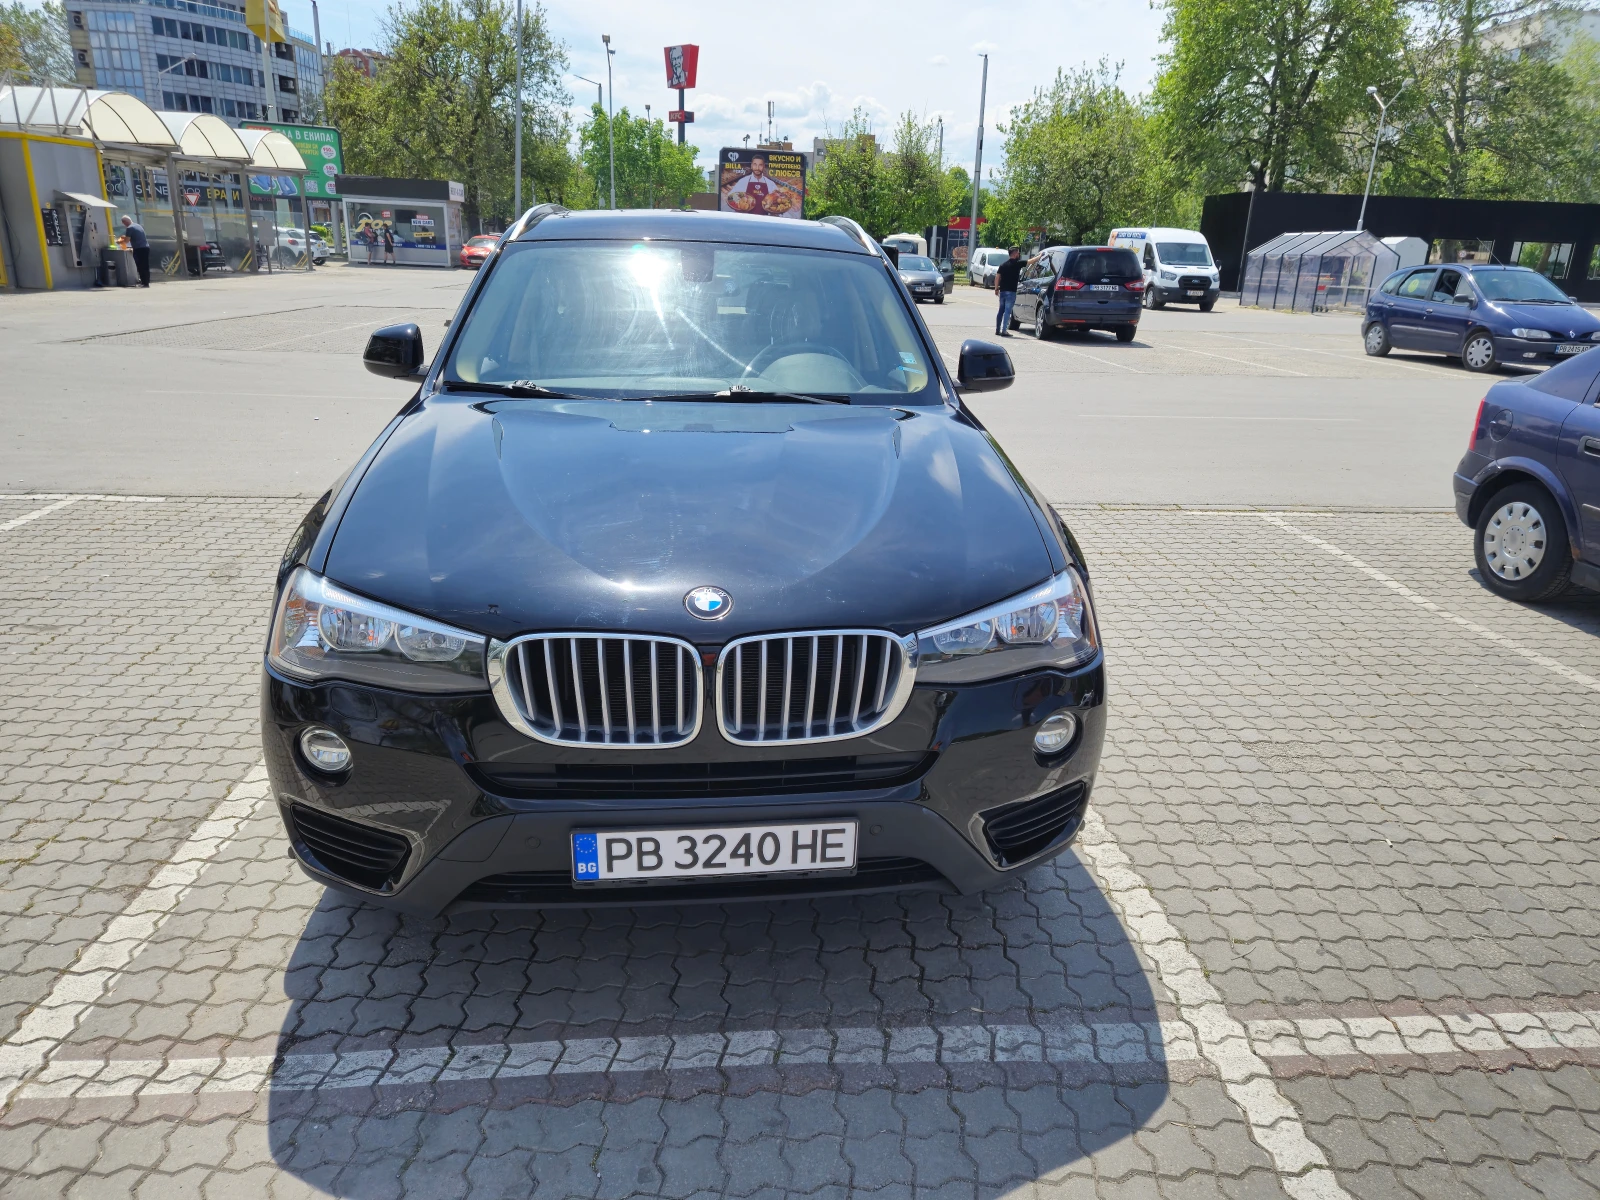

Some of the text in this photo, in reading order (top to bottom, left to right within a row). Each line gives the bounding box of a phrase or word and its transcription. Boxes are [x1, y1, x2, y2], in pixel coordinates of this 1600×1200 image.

[670, 112, 682, 120] KFC
[304, 132, 334, 143] ЕКИПА!
[769, 155, 795, 163] ВКУСНО
[605, 828, 846, 873] PB 3240 HE
[577, 862, 597, 874] BG
